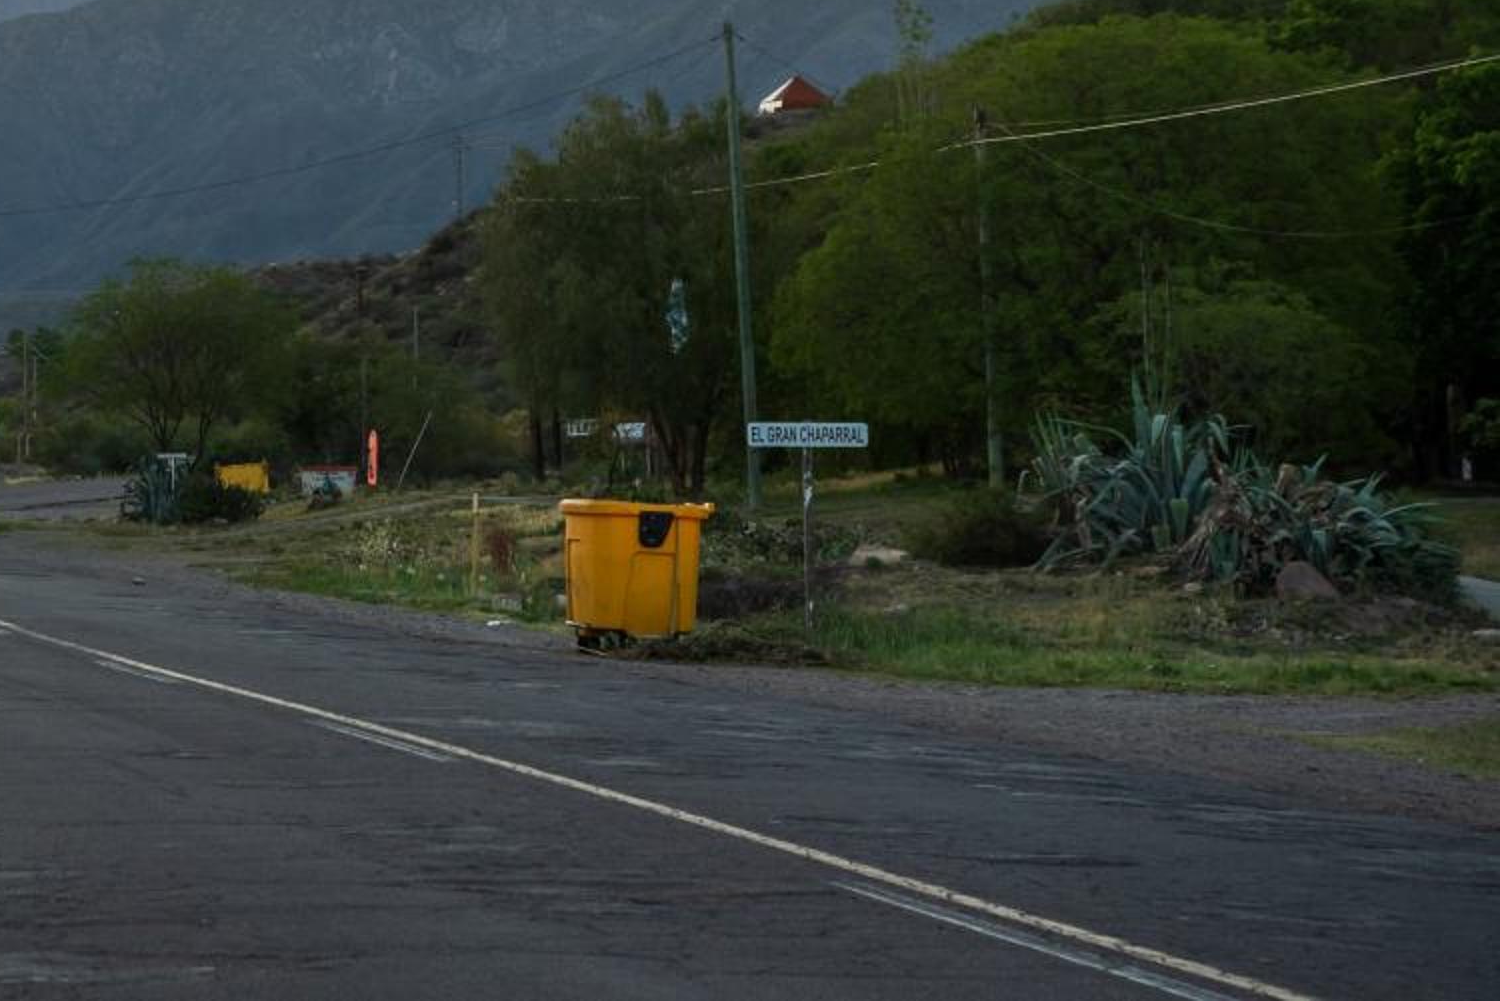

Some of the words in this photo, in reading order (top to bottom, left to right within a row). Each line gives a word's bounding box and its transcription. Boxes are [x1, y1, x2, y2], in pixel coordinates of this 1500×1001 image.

[751, 426, 764, 442] EL
[768, 426, 797, 443] GRAN
[800, 426, 865, 444] CHAPARRAL
